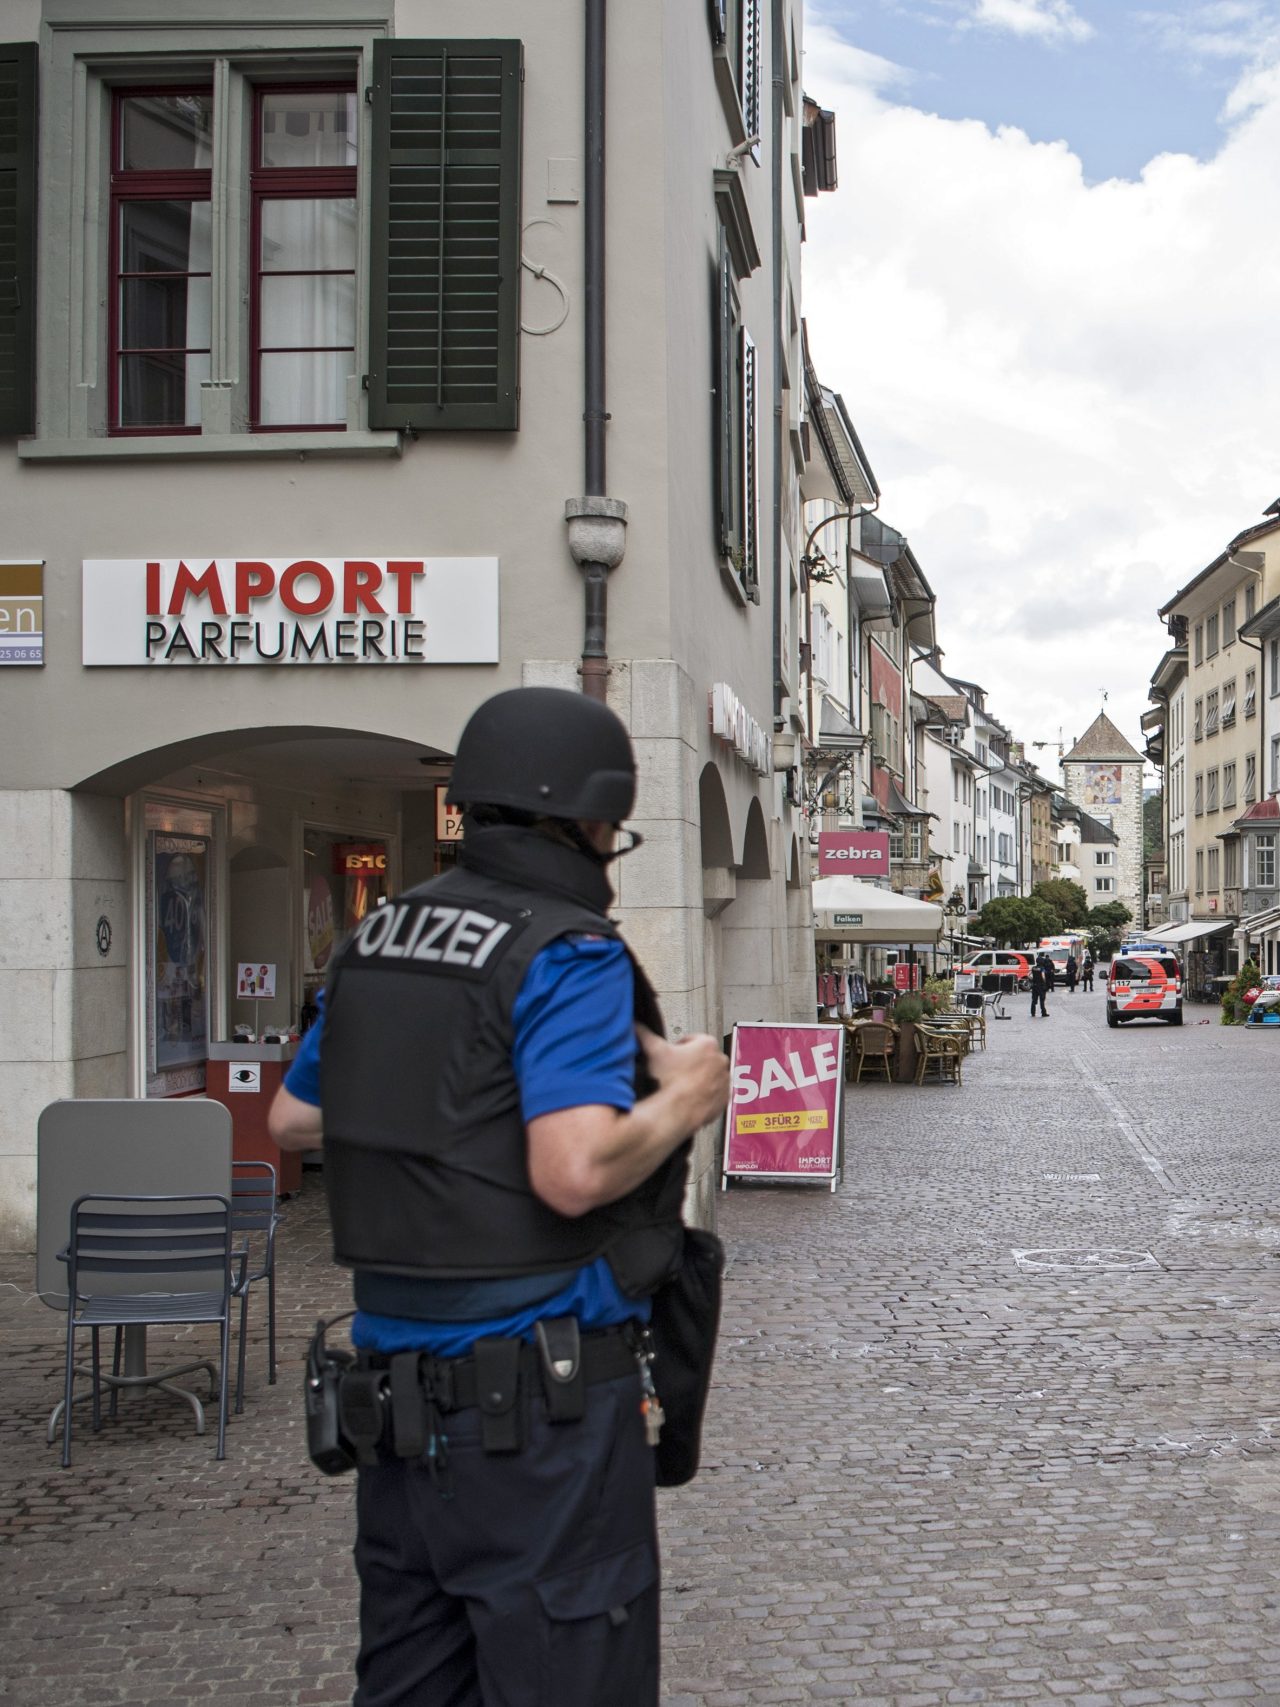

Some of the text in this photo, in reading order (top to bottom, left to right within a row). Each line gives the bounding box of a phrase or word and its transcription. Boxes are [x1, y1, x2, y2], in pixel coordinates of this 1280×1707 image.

[146, 560, 424, 616] IMPORT
[146, 620, 424, 659] PARFUMERIE
[15, 650, 26, 659] 06
[30, 650, 41, 659] 65
[825, 846, 882, 859] zebra
[836, 914, 861, 923] Falken
[733, 1042, 839, 1104] SALE
[798, 1156, 831, 1164] IMPORT
